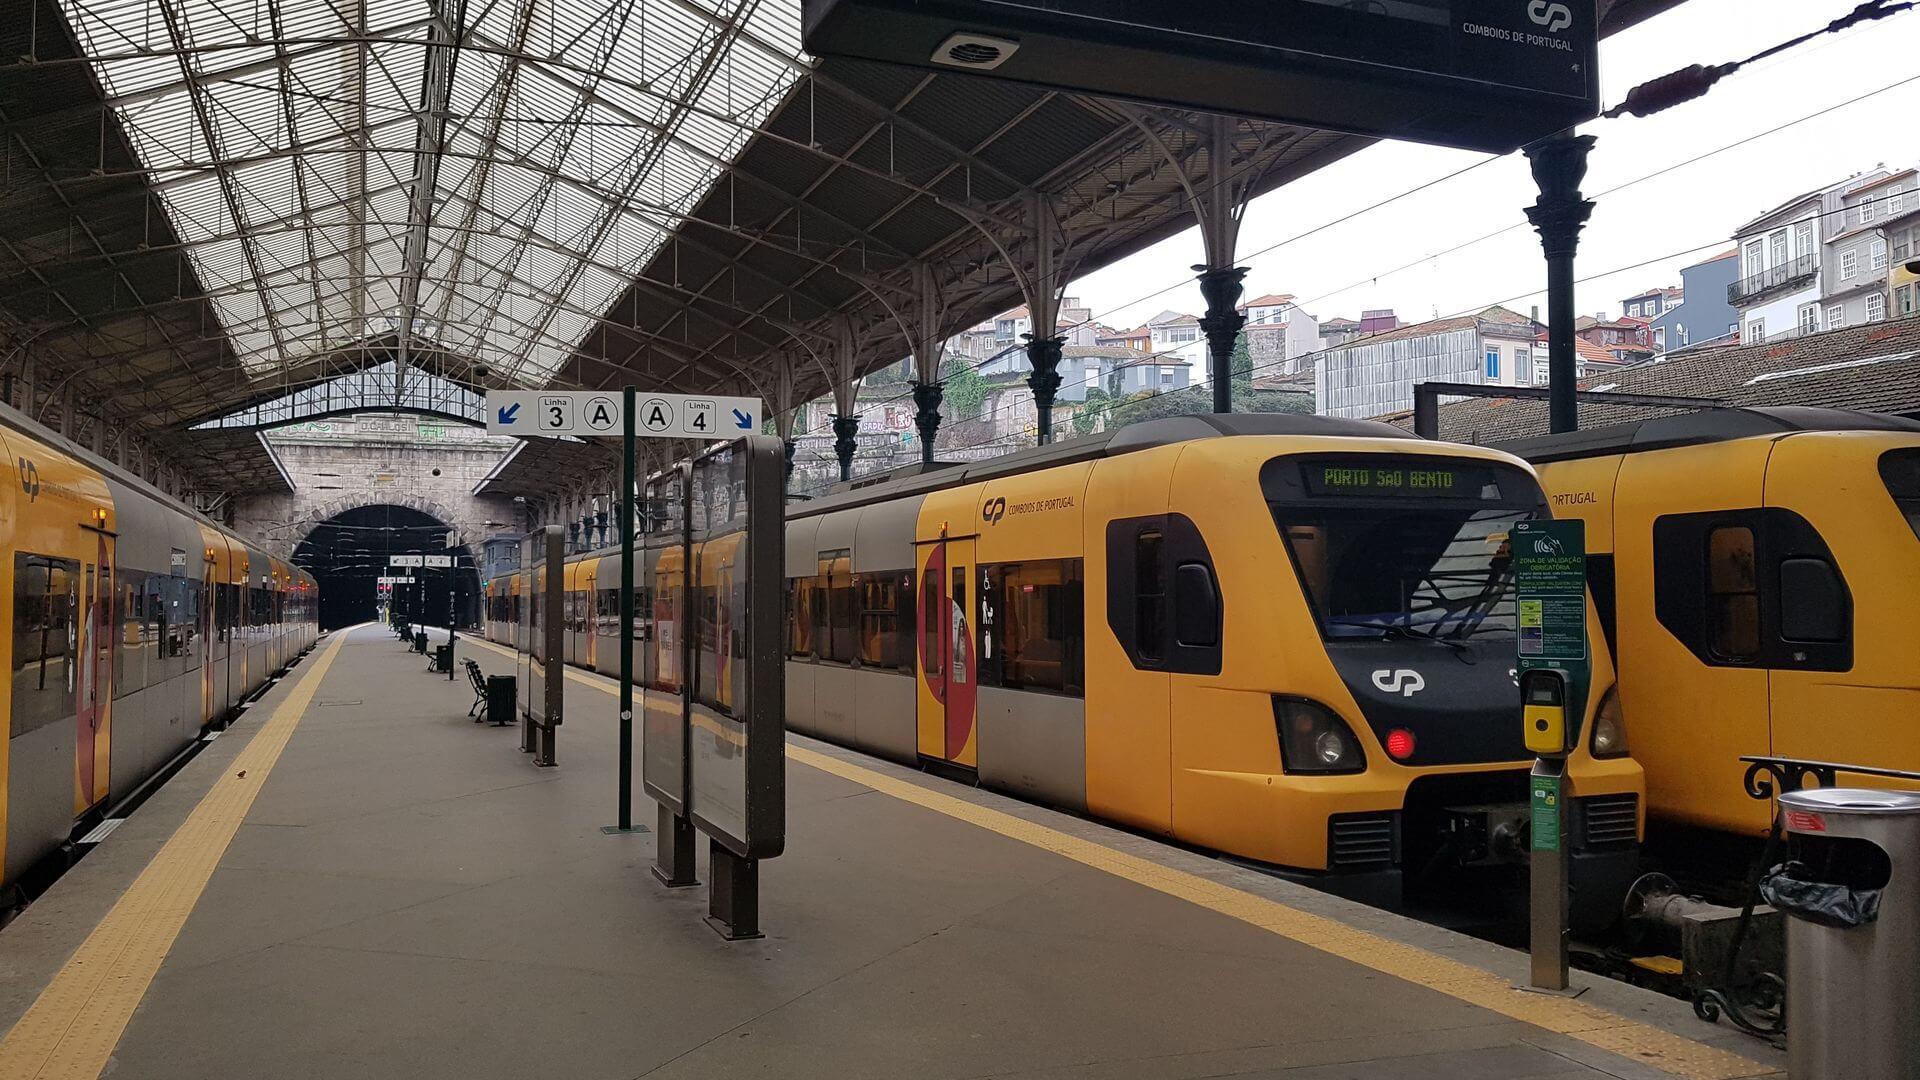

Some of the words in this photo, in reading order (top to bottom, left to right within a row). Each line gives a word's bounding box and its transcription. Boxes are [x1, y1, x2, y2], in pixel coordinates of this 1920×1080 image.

[1463, 22, 1510, 41] COMBOIOS
[1512, 31, 1524, 43] DE
[1526, 33, 1573, 52] PORTUGAL
[544, 398, 567, 407] Linha
[689, 402, 710, 410] Linha
[549, 406, 563, 428] 3
[591, 405, 611, 424] A
[647, 406, 667, 426] A
[693, 411, 706, 431] 4
[1324, 468, 1369, 485] PORTO
[1409, 471, 1453, 488] BENTO
[1008, 502, 1035, 515] COMBOIOS
[1036, 501, 1043, 512] DE
[1044, 495, 1075, 511] PORTUGAL
